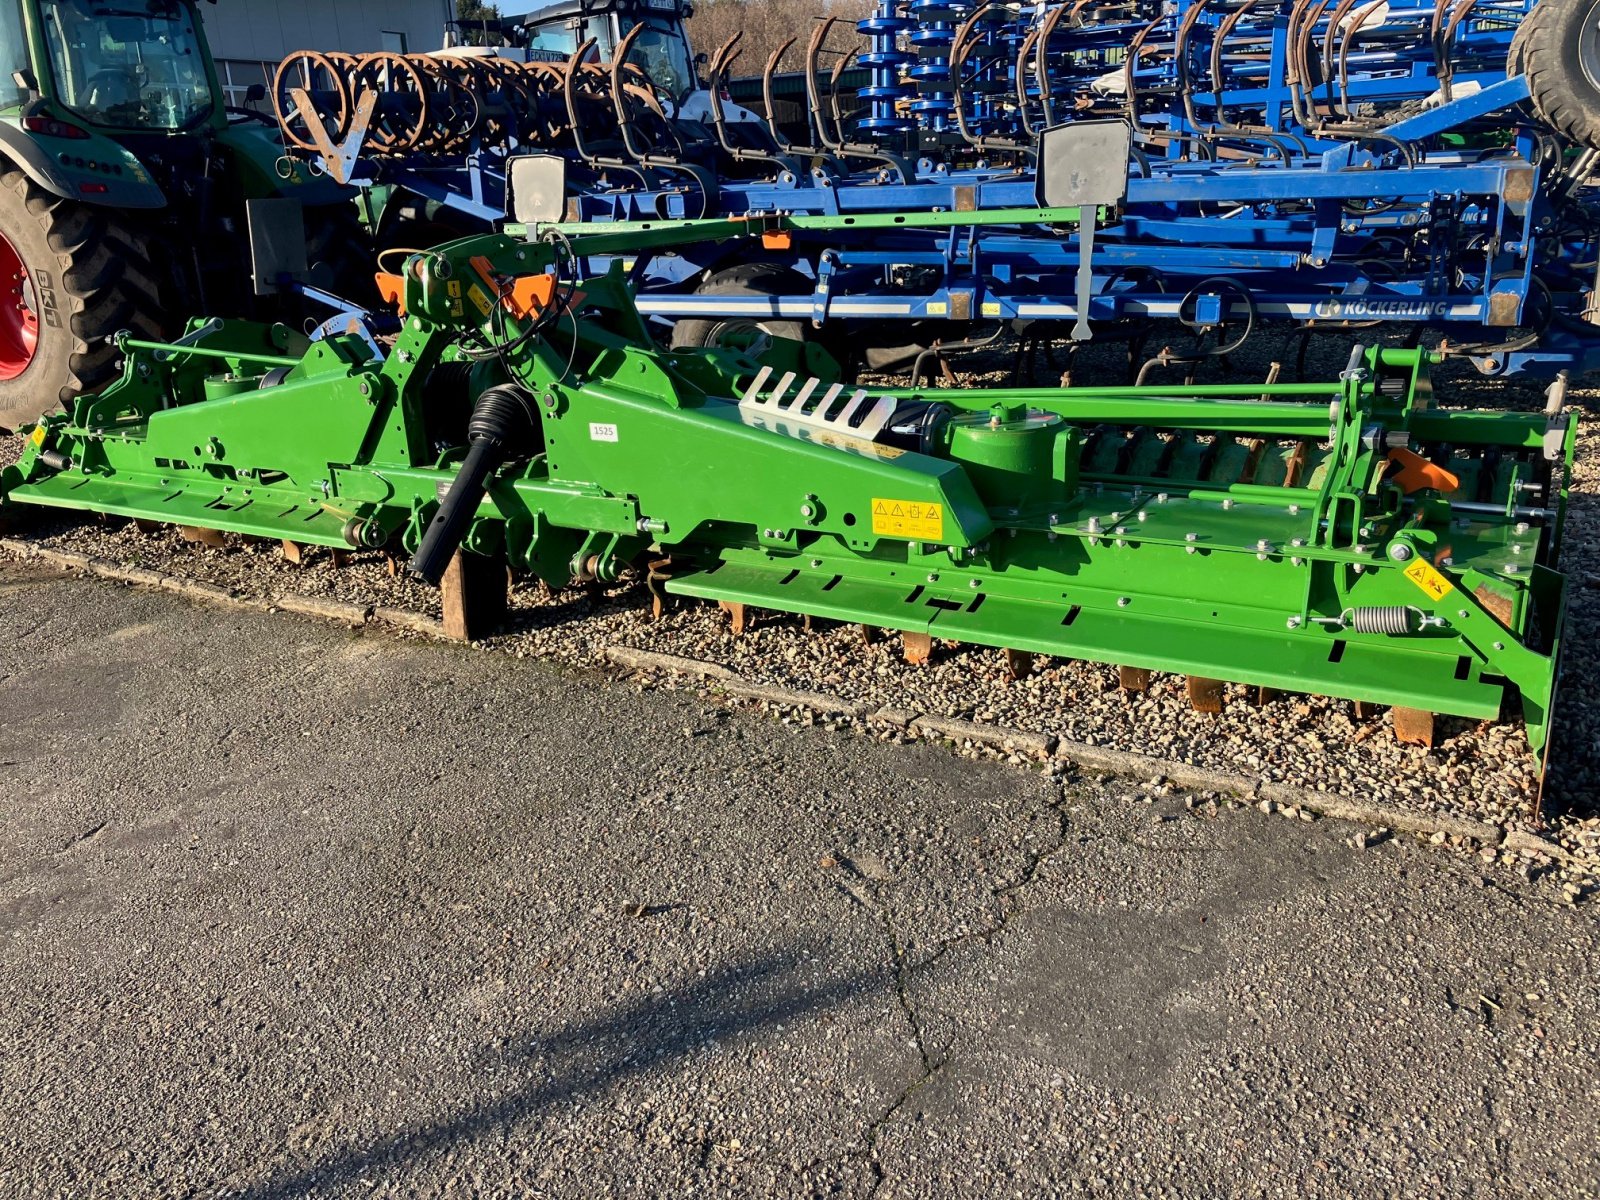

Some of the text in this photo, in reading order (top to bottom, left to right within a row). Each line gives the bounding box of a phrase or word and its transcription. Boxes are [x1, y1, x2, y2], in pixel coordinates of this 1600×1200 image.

[36, 269, 62, 328] BKT
[1344, 299, 1447, 316] KÖCKERLING
[594, 426, 614, 436] 1525
